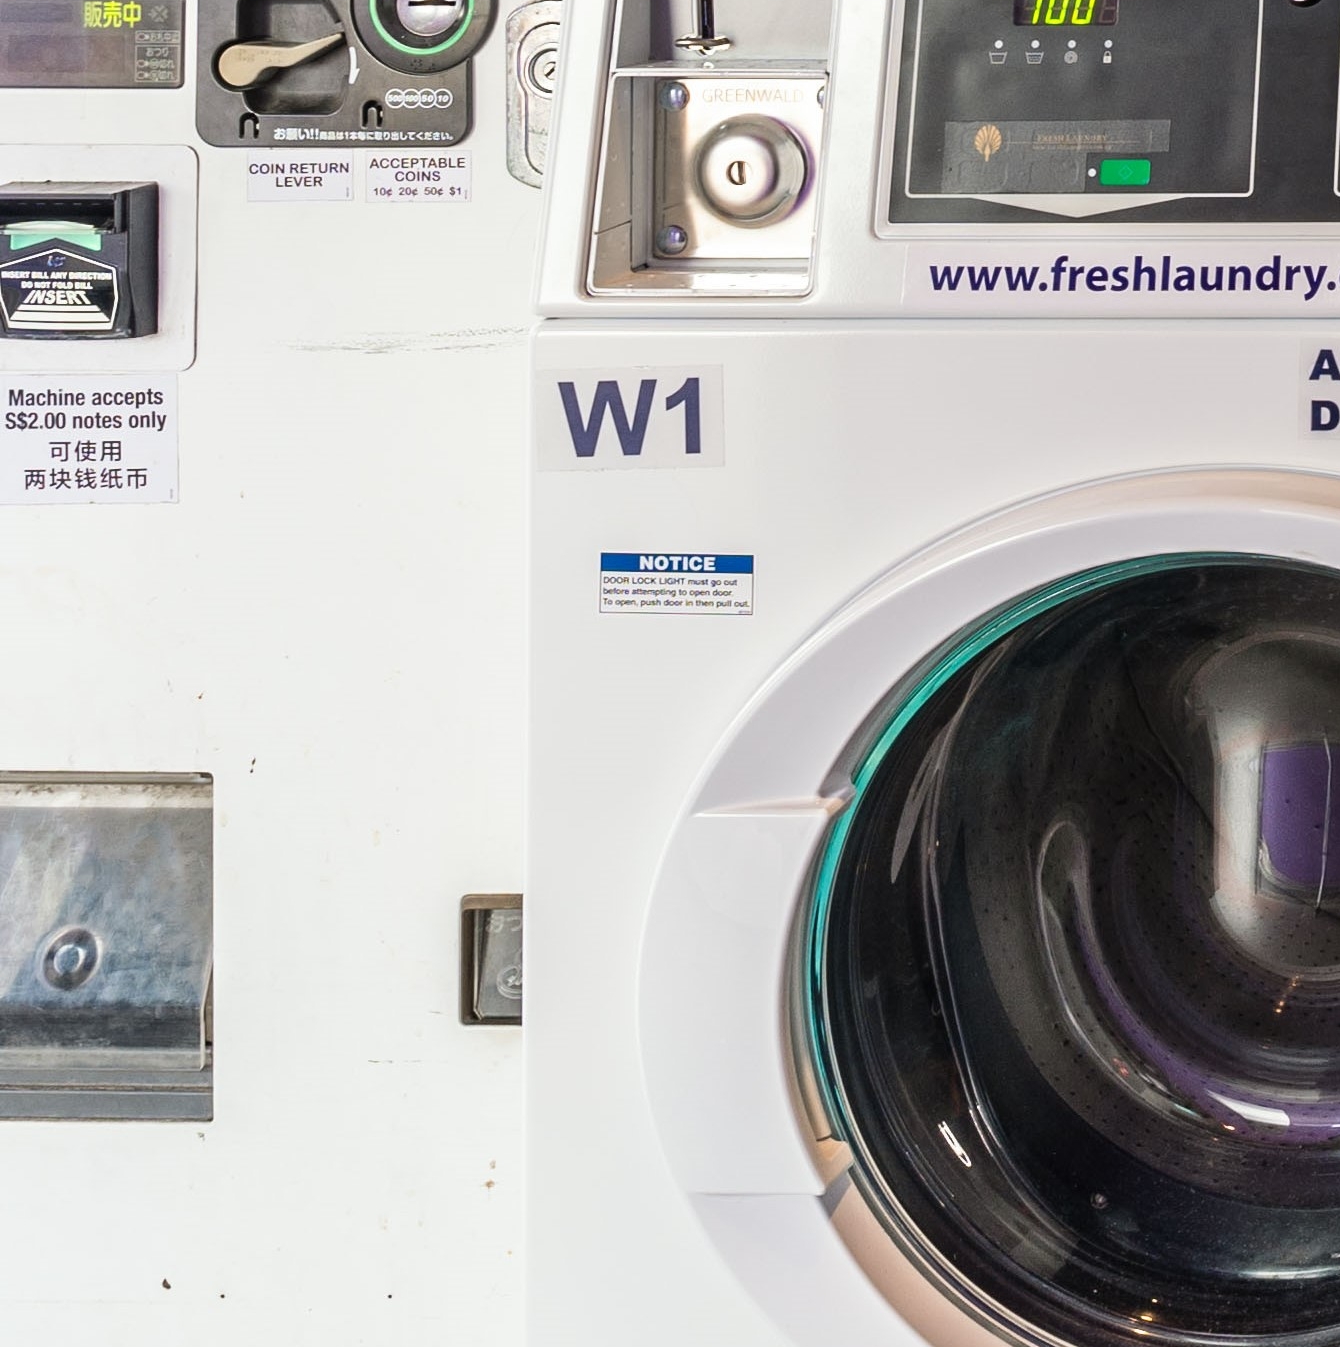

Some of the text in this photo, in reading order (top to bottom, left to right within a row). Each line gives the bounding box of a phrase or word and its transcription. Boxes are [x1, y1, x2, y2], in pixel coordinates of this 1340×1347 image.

[84, 1, 142, 28] 販売中
[702, 88, 804, 103] GREENWALD
[249, 163, 349, 174] COIN RETURN
[370, 158, 465, 168] ACCEPTABLE
[276, 177, 322, 187] LEVER
[395, 171, 440, 181] COINS
[374, 187, 462, 197] 10¢ 20¢ 50¢ $1
[24, 290, 91, 305] INSERT
[8, 389, 164, 409] Machine accepts
[6, 411, 167, 431] S$2.00 notes only
[558, 378, 701, 457] W1
[49, 440, 122, 462] 可使用
[24, 468, 148, 490] 两块钱纸币
[640, 556, 716, 571] NOTICE
